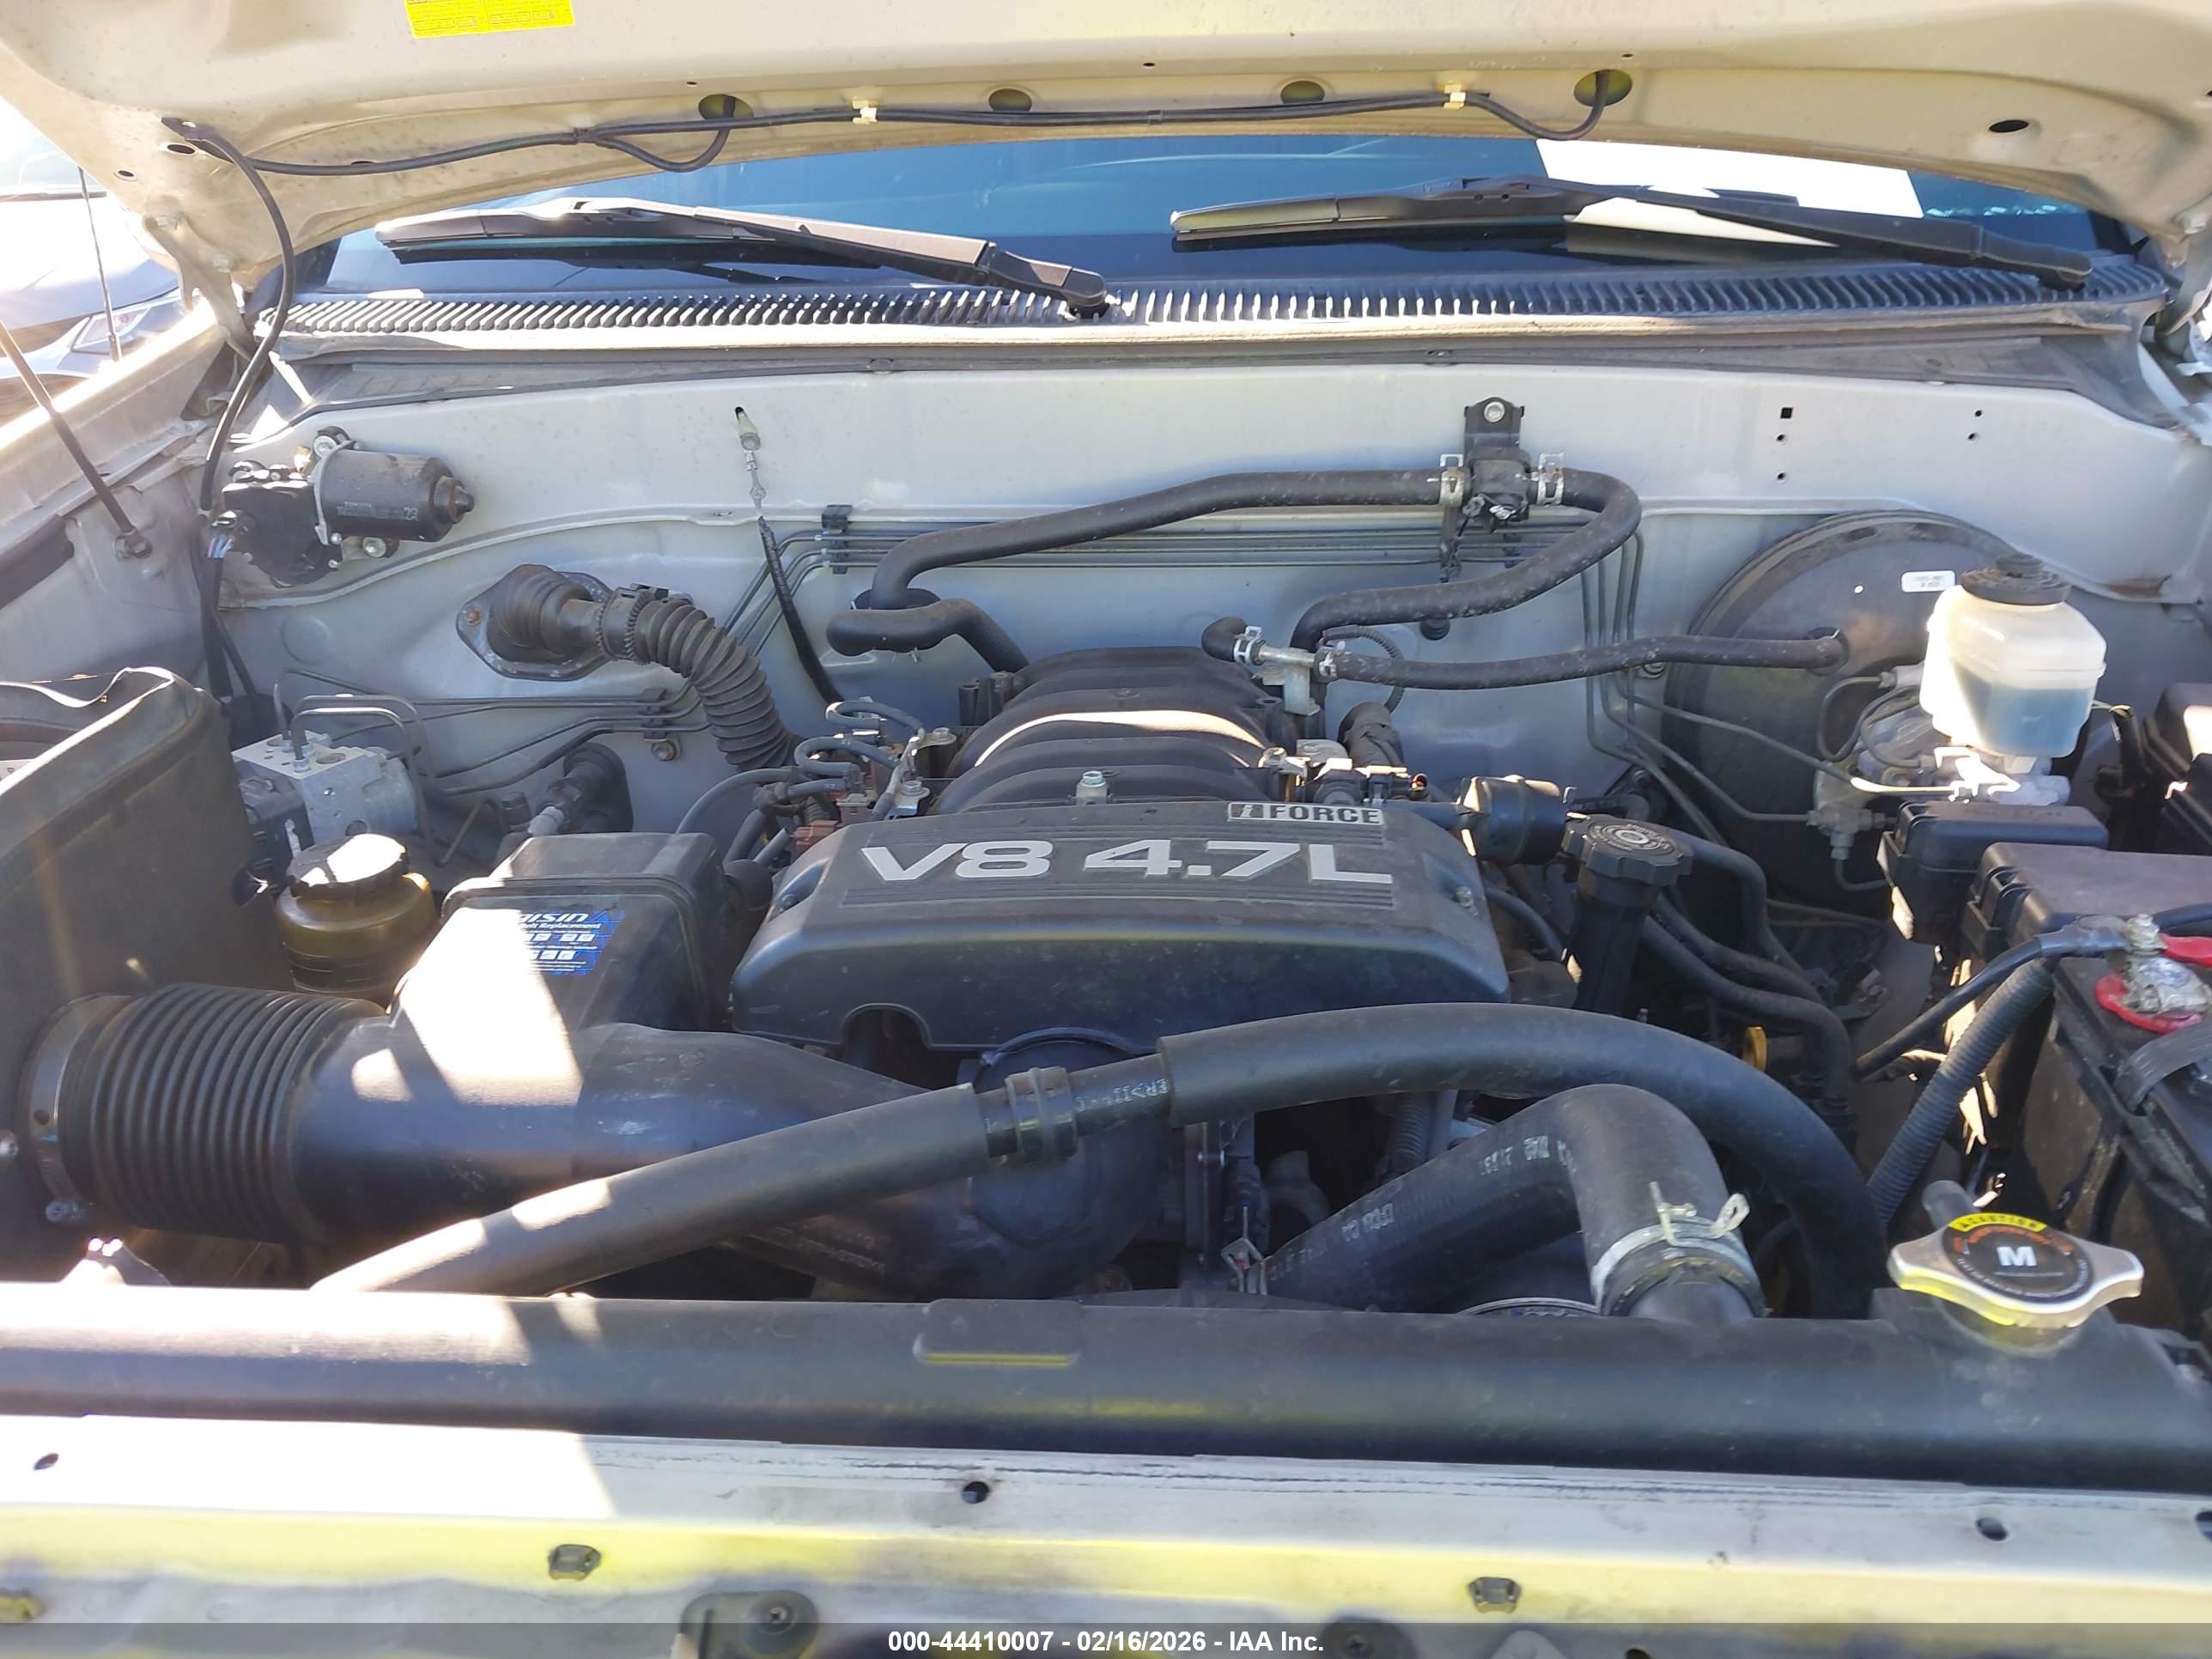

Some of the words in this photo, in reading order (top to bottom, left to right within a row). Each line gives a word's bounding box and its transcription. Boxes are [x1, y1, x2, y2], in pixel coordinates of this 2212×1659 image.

[1269, 805, 1380, 824] FORCE
[861, 840, 1054, 881] V8
[1084, 840, 1393, 884] 4.7L
[1995, 1245, 2038, 1267] M
